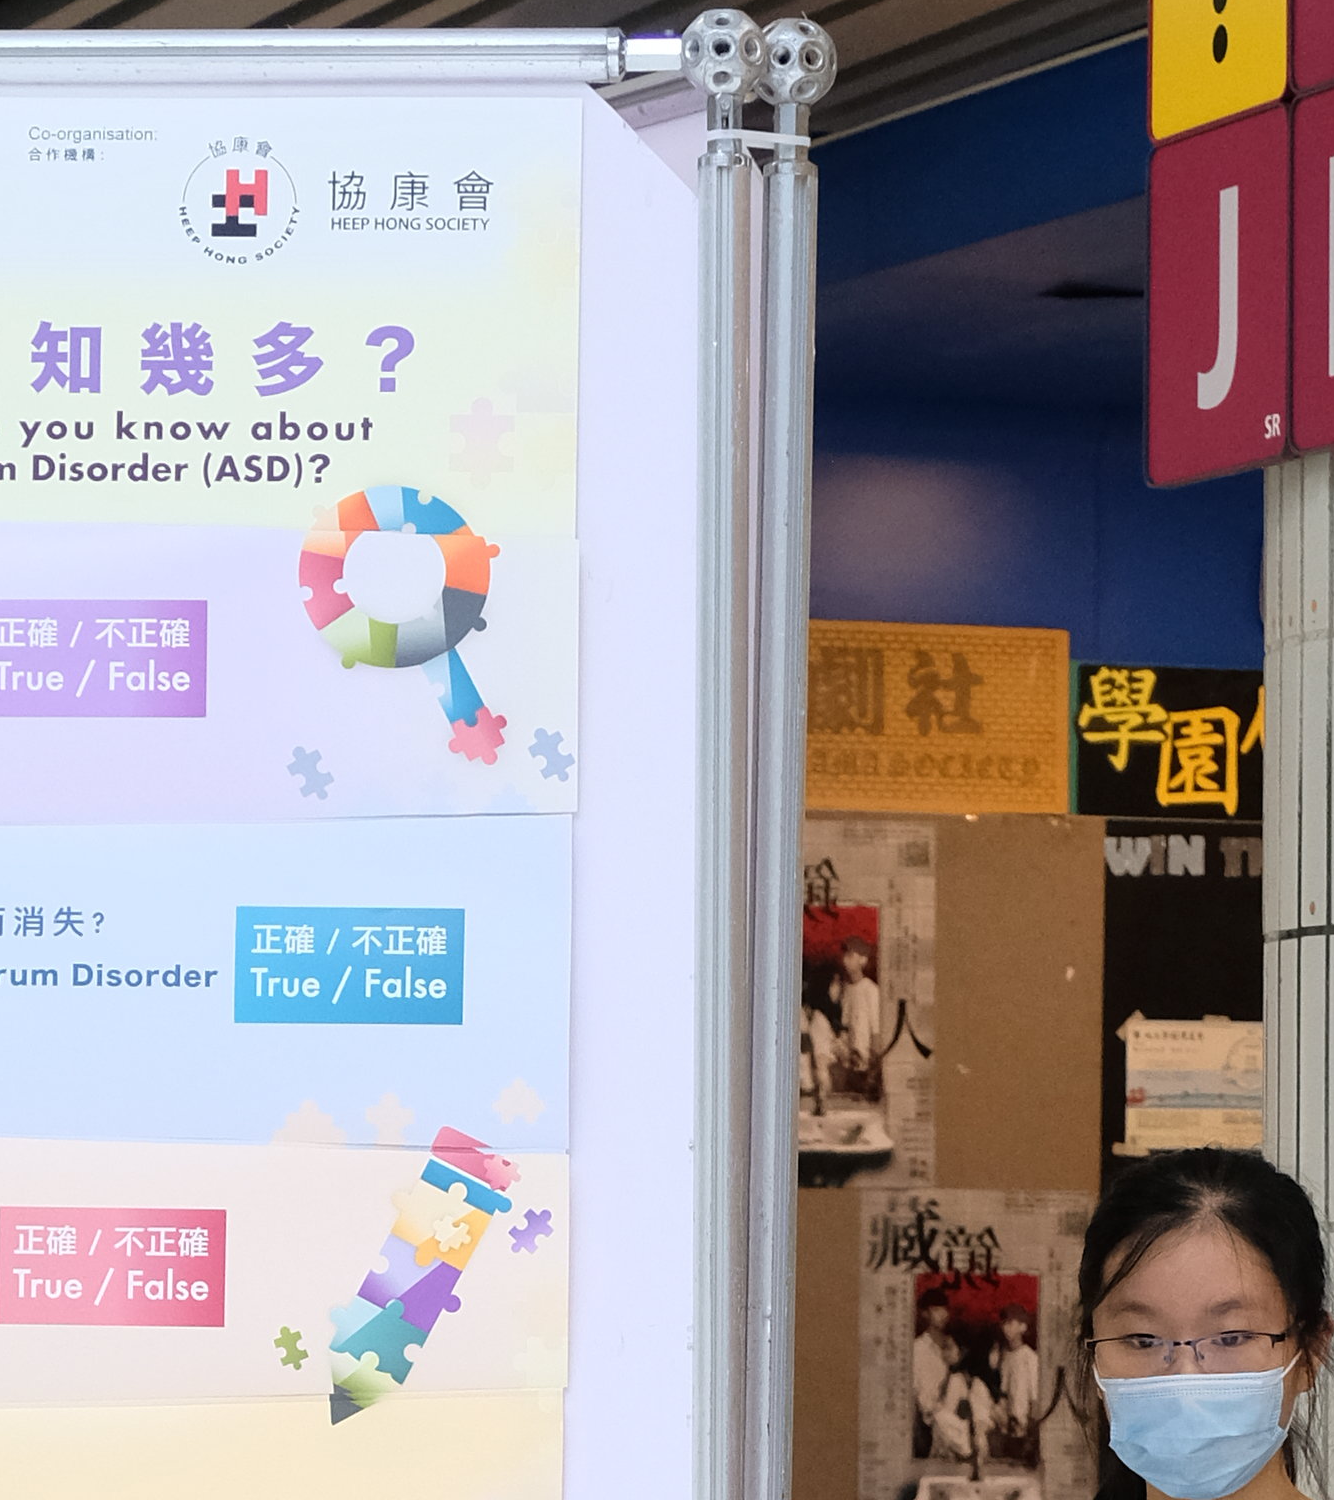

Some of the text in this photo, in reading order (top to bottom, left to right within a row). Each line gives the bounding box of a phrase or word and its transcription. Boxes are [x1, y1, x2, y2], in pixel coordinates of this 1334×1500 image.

[29, 126, 157, 144] Co-organisation:
[327, 170, 494, 212] 協康會
[179, 206, 300, 264] HEEP HONG SOCIETY
[330, 217, 490, 231] HEEP HONG SOCIETY
[1197, 185, 1239, 411] J
[19, 420, 94, 449] you
[116, 410, 231, 441] know
[250, 410, 374, 442] about
[1264, 413, 1281, 439] SR
[32, 452, 189, 483] Disorder
[203, 452, 331, 489] (ASD)?
[70, 621, 83, 647] /
[95, 618, 190, 649] 不正確
[76, 660, 96, 697] /
[109, 661, 191, 691] False
[1078, 666, 1266, 816] 學園
[1104, 834, 1206, 877] WIN
[251, 925, 447, 957] 正確 / 不正確
[72, 963, 219, 988] Disorder
[250, 966, 447, 1004] True / False
[14, 1226, 209, 1258] 正確 / 不正確
[13, 1268, 209, 1305] True / False
